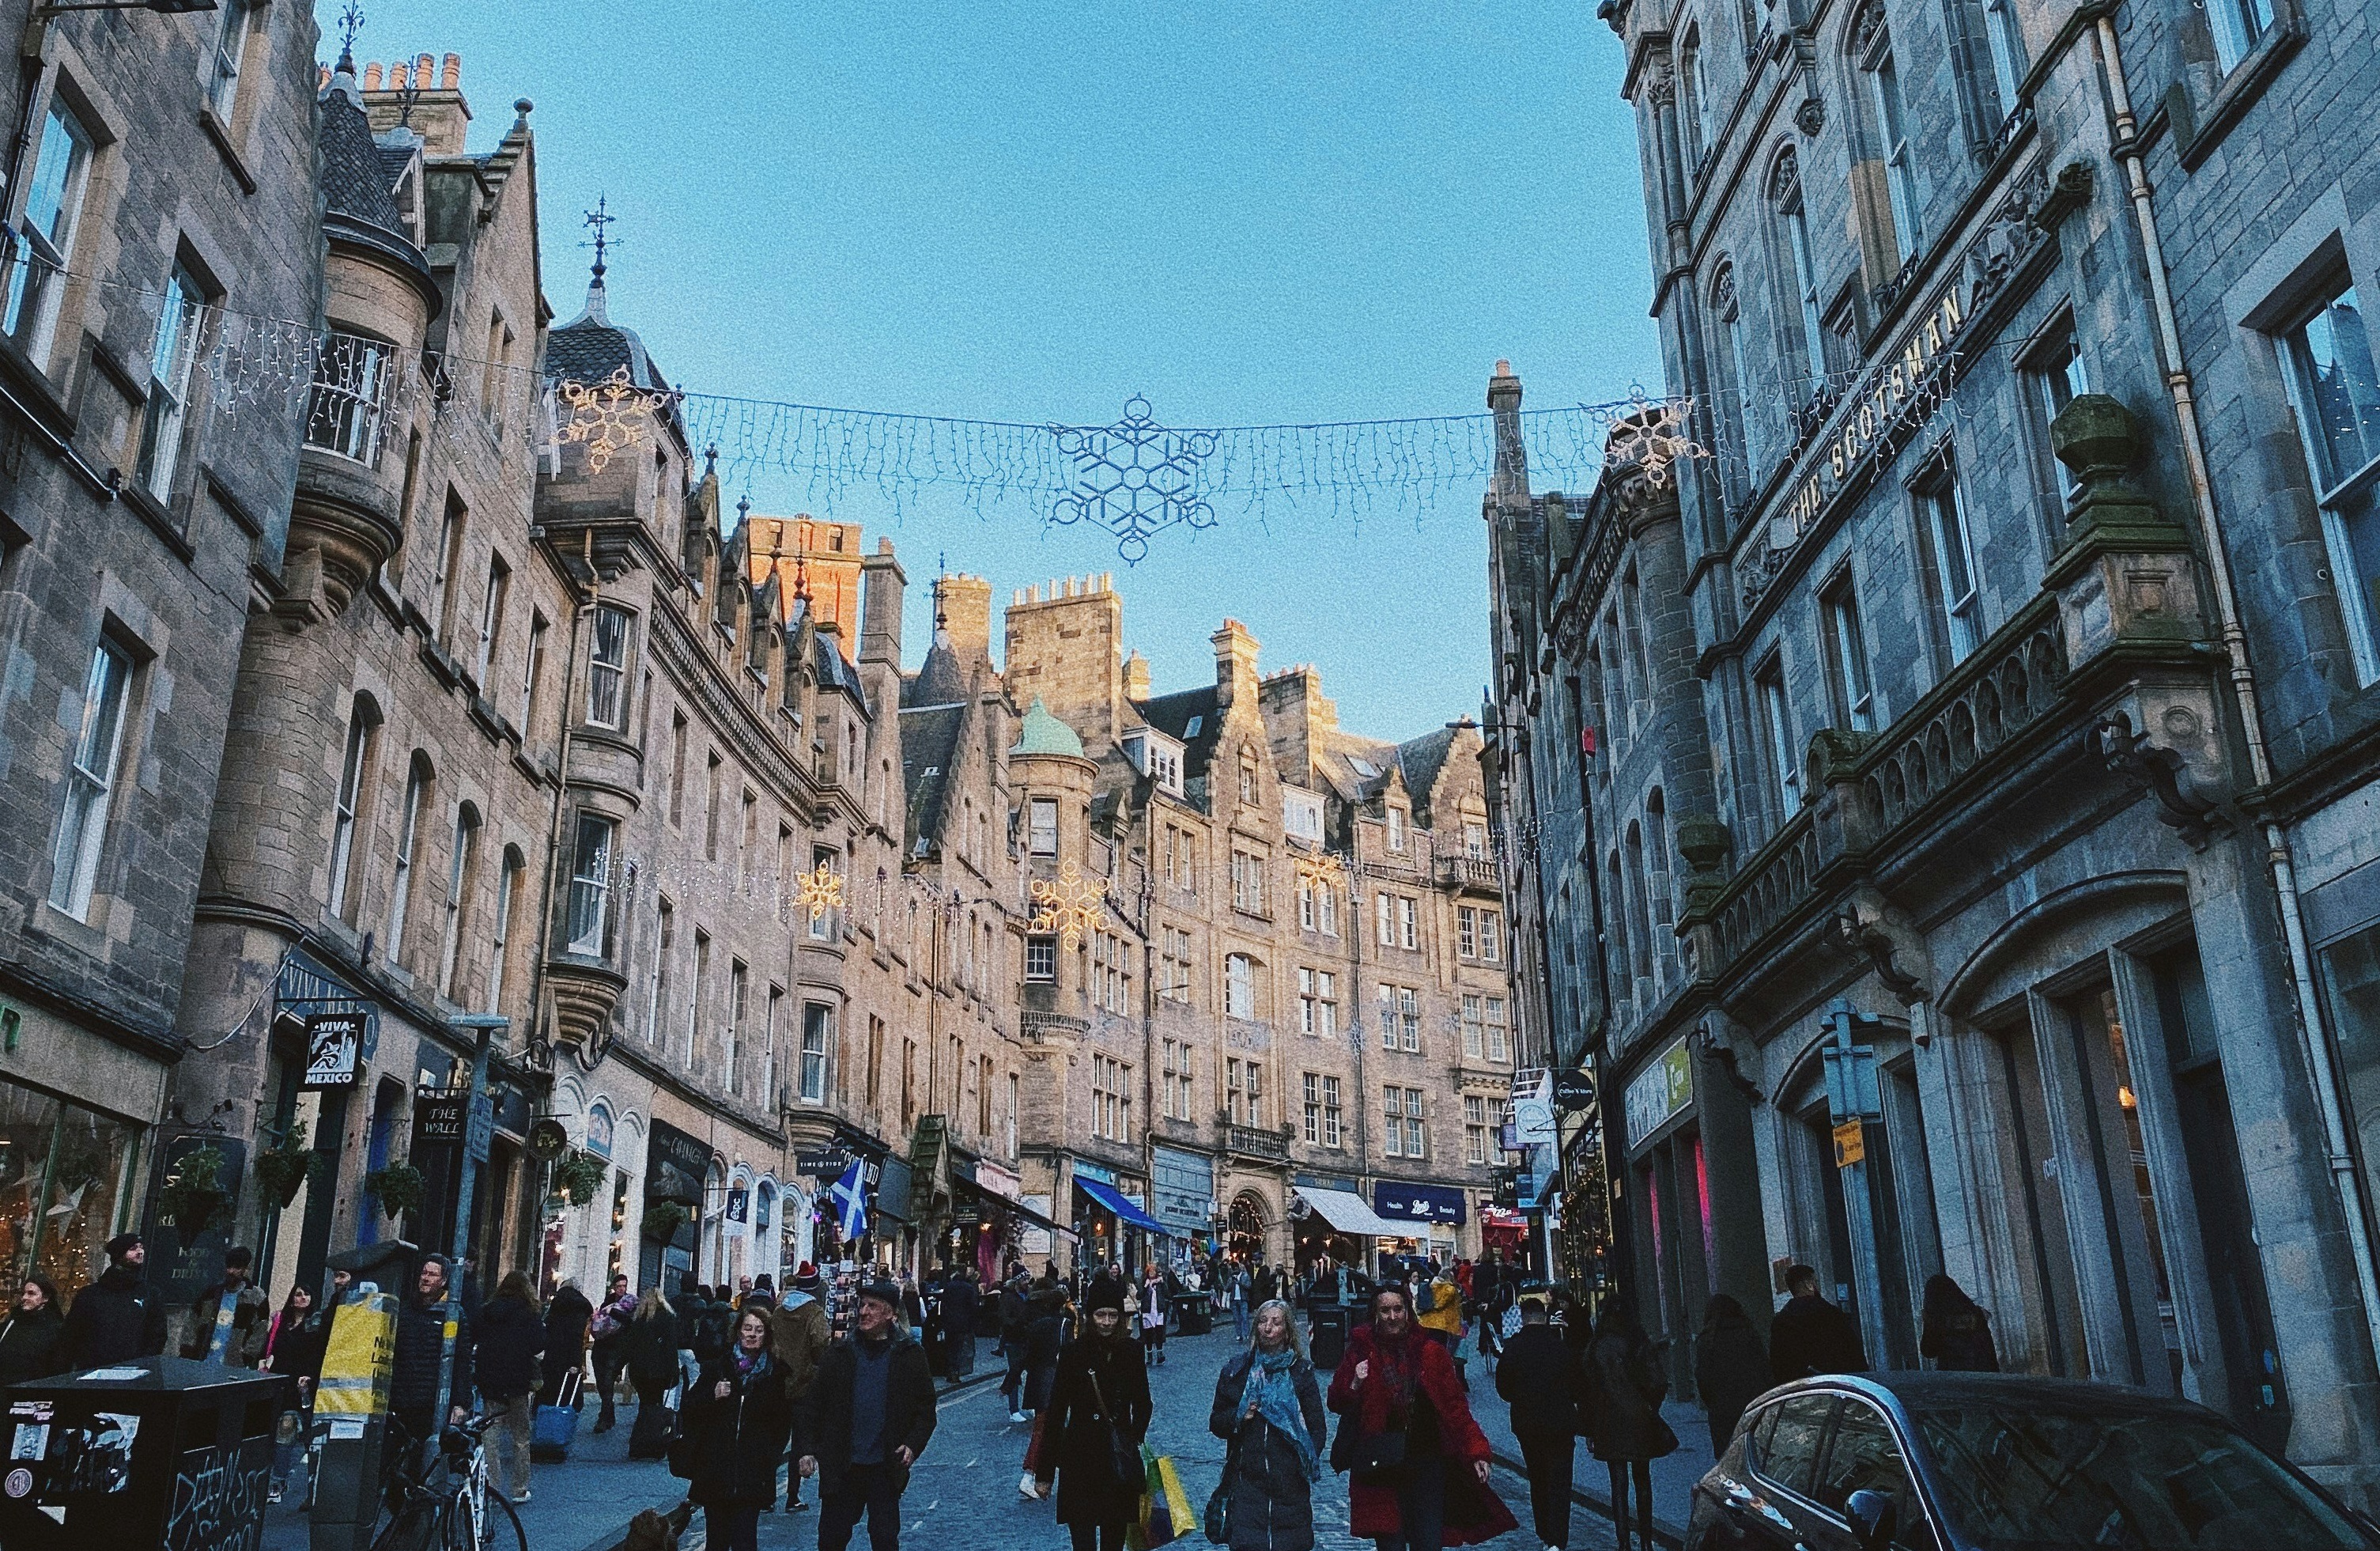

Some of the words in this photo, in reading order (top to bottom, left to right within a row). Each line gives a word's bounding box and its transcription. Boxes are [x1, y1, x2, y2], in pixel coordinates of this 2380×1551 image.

[1789, 474, 1821, 537] THE
[1832, 286, 1963, 481] SCOTSMAN
[289, 959, 319, 1008] VIVA
[319, 1021, 350, 1031] VIVA
[304, 1073, 353, 1084] MEXICO
[429, 1105, 459, 1120] THE
[425, 1122, 459, 1134] WALL
